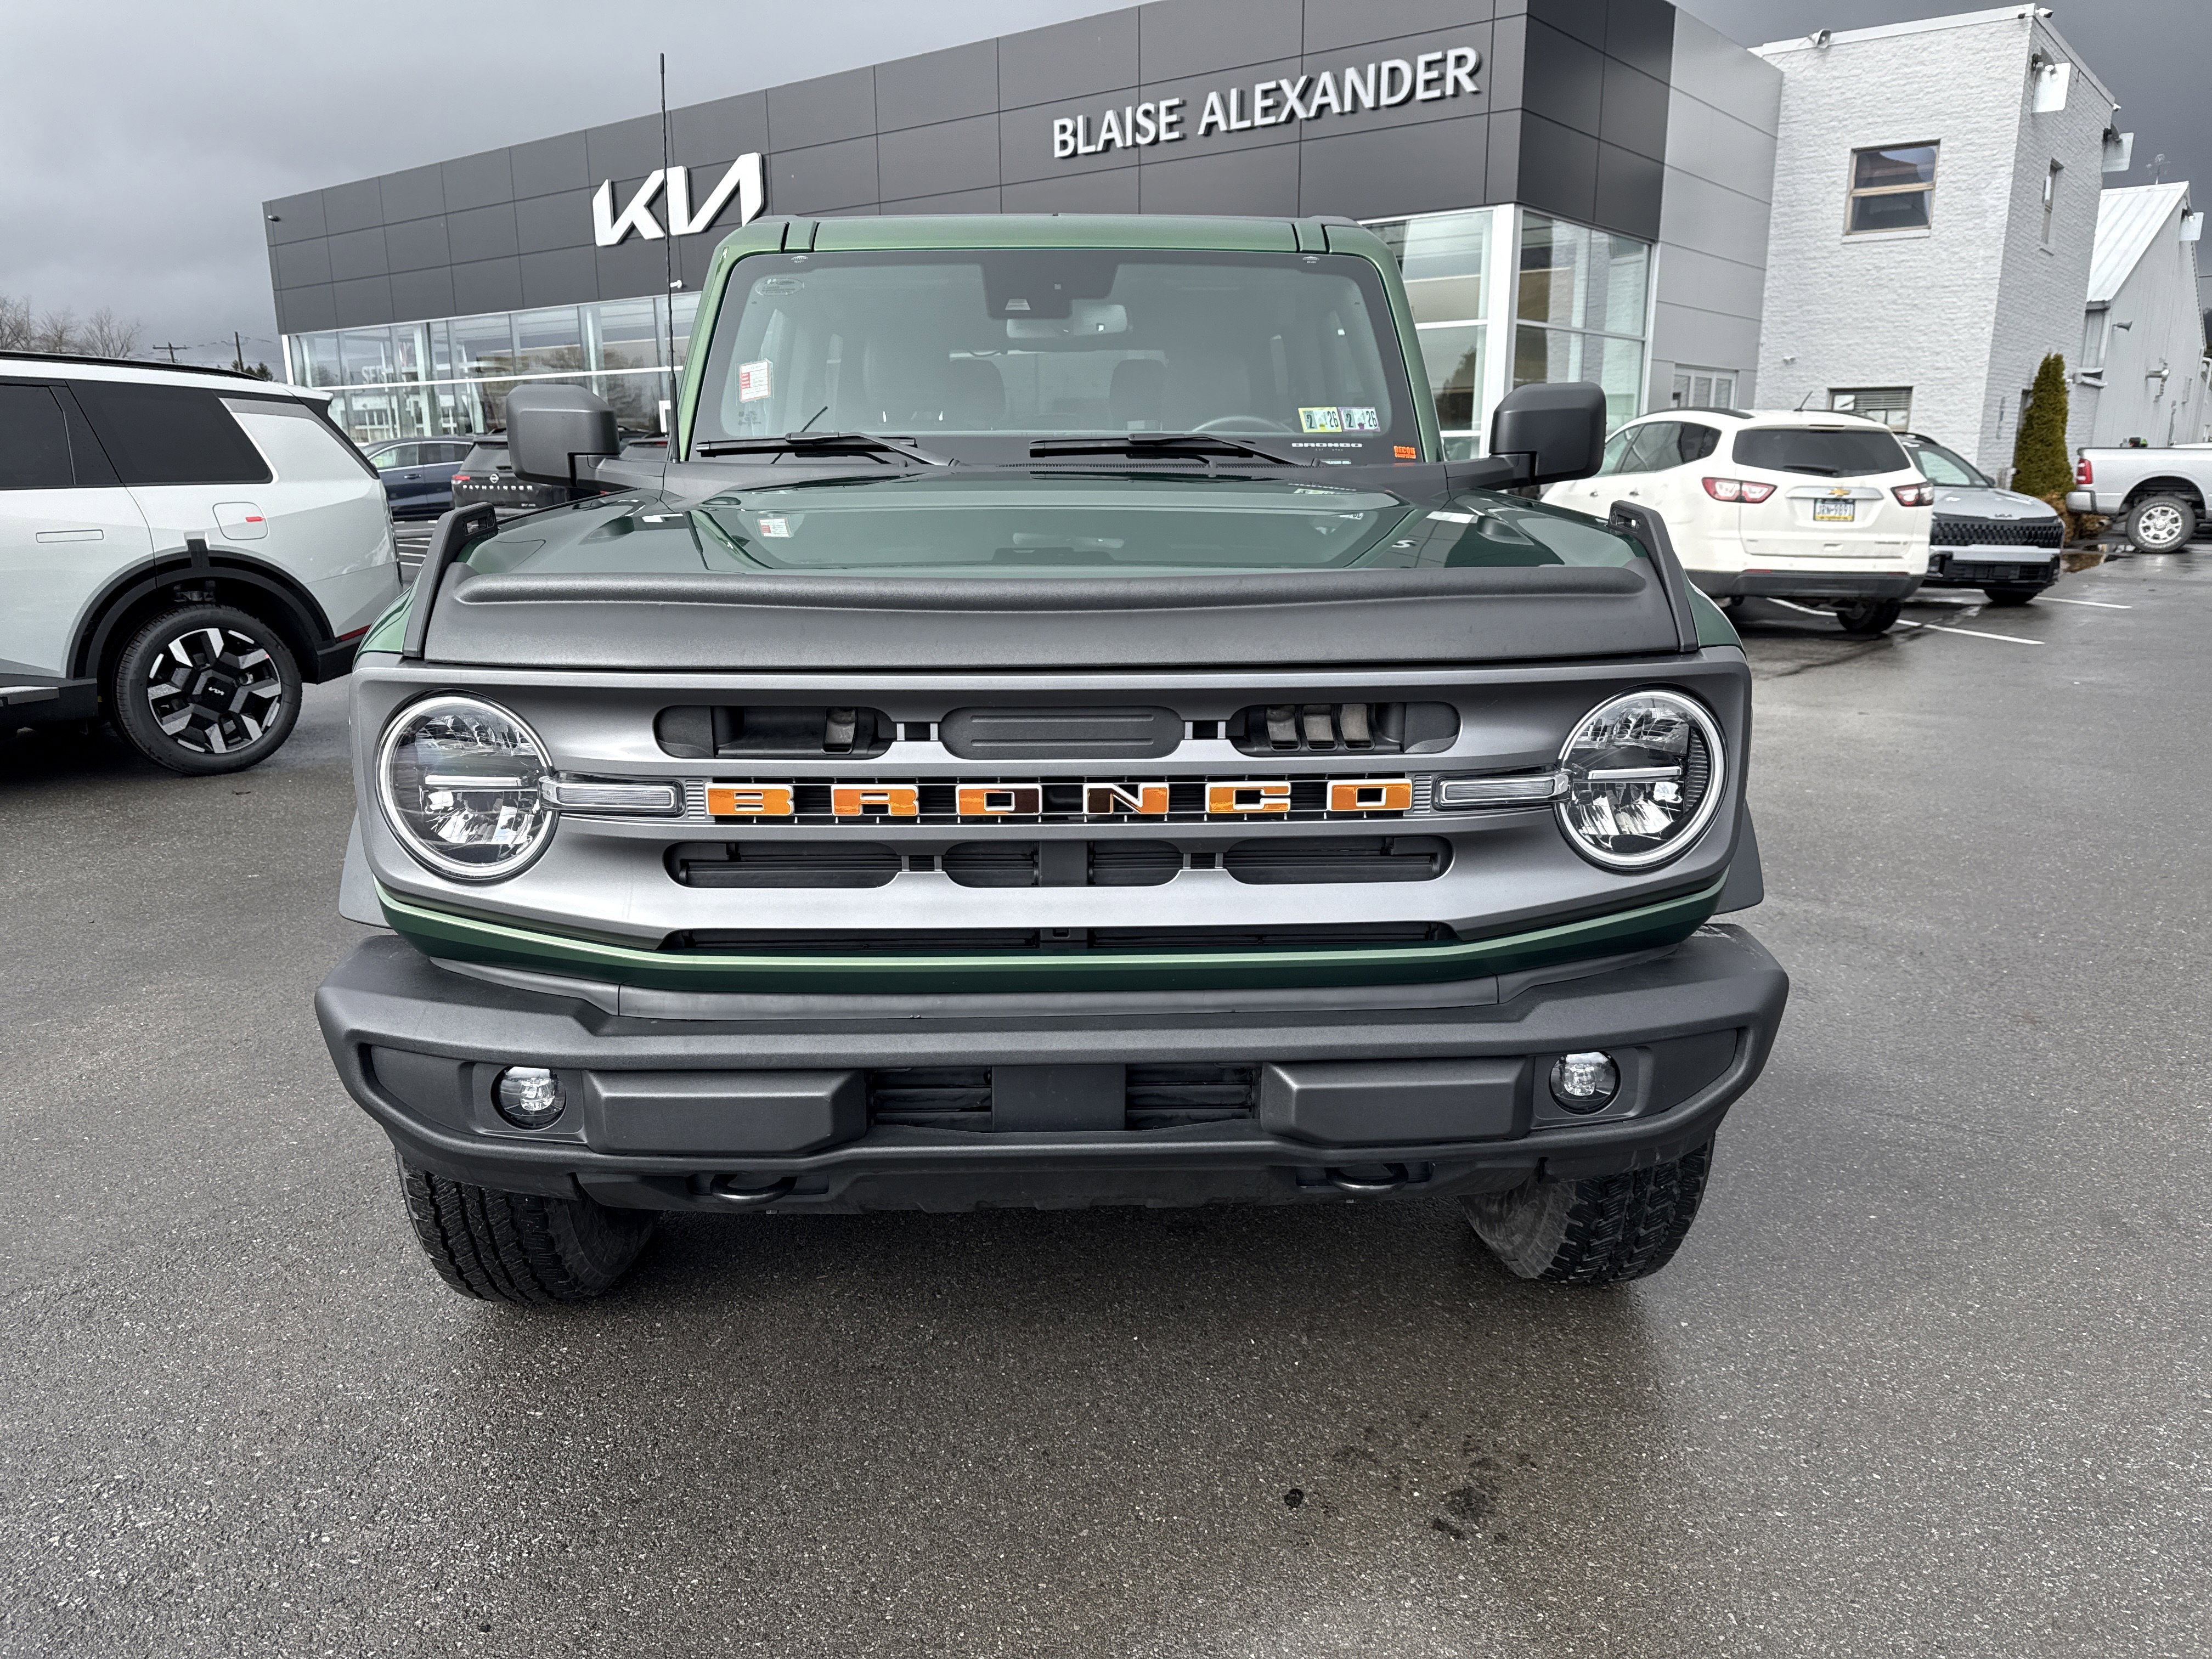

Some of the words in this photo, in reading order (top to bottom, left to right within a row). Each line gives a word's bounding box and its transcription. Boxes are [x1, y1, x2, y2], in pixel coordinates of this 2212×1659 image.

[1053, 97, 1184, 158] BLAISE
[1198, 46, 1480, 135] ALEXANDER
[592, 152, 764, 246] KIA
[1327, 410, 1339, 427] 26
[1366, 410, 1378, 427] 26
[704, 777, 1413, 817] BRONCO
